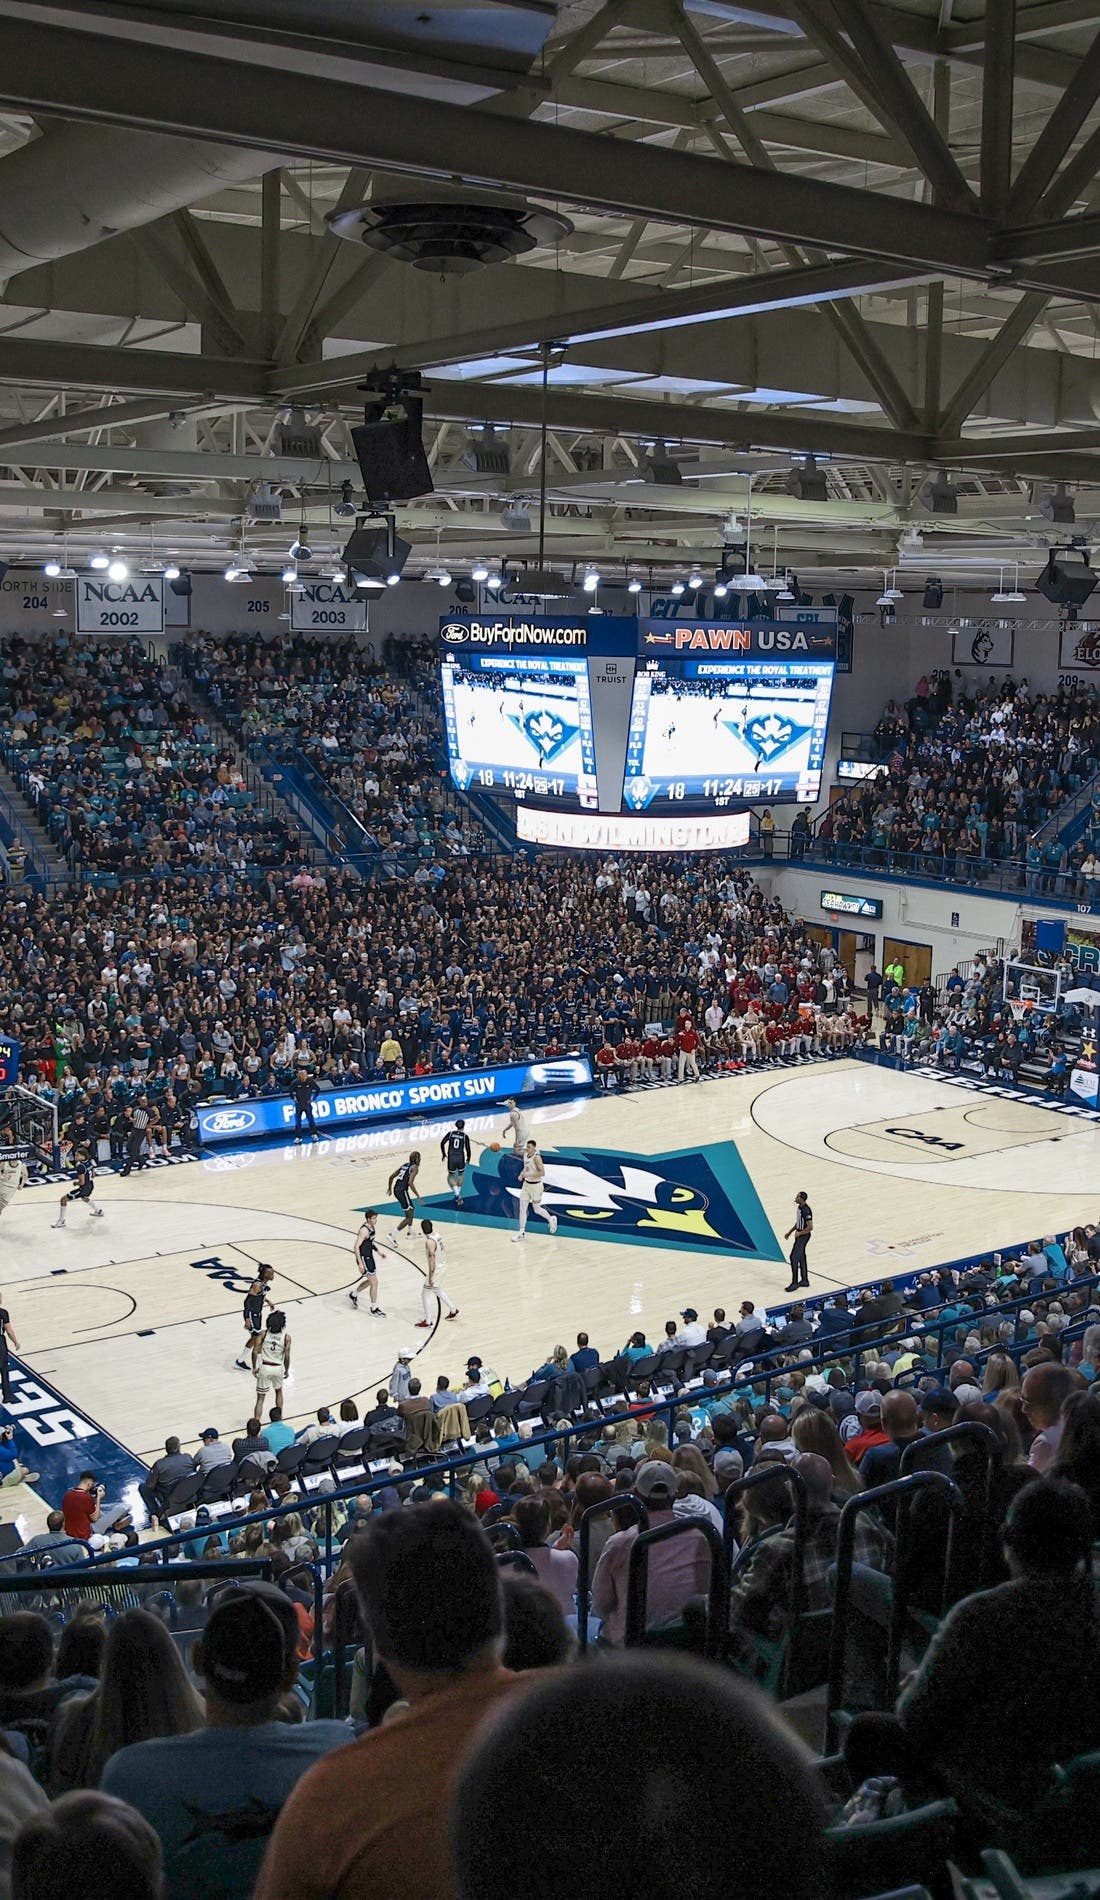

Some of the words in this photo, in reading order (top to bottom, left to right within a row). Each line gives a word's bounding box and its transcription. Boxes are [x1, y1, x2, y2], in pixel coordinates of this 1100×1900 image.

[42, 582, 73, 593] SIDE
[84, 582, 160, 603] NCAA
[23, 597, 48, 609] 204
[247, 601, 270, 613] 205
[100, 612, 139, 626] 2002
[312, 611, 346, 624] 2003
[446, 626, 464, 640] Ford
[470, 623, 587, 646] BuyFordNow.com
[675, 628, 751, 650] PAWN
[758, 631, 810, 651] USA
[697, 664, 745, 675] EXPERIENCE
[746, 665, 761, 675] THE
[761, 665, 788, 675] ROYAL
[789, 665, 831, 676] TREATMENT
[596, 676, 627, 684] TRUIST
[1058, 675, 1079, 687] 209
[478, 769, 494, 786] 18
[503, 770, 533, 790] 11:24
[552, 779, 565, 796] 17
[666, 783, 685, 800] 18
[702, 779, 742, 797] 11:24
[745, 782, 759, 795] 25
[766, 779, 782, 796] 17
[714, 797, 730, 807] 1ST
[1077, 904, 1092, 914] 107
[213, 1103, 246, 1129] Ford
[409, 1081, 461, 1105] SPORT
[463, 1076, 496, 1097] SUV
[453, 1138, 460, 1149] 0
[884, 1128, 966, 1151] CAA
[271, 1341, 277, 1351] 3
